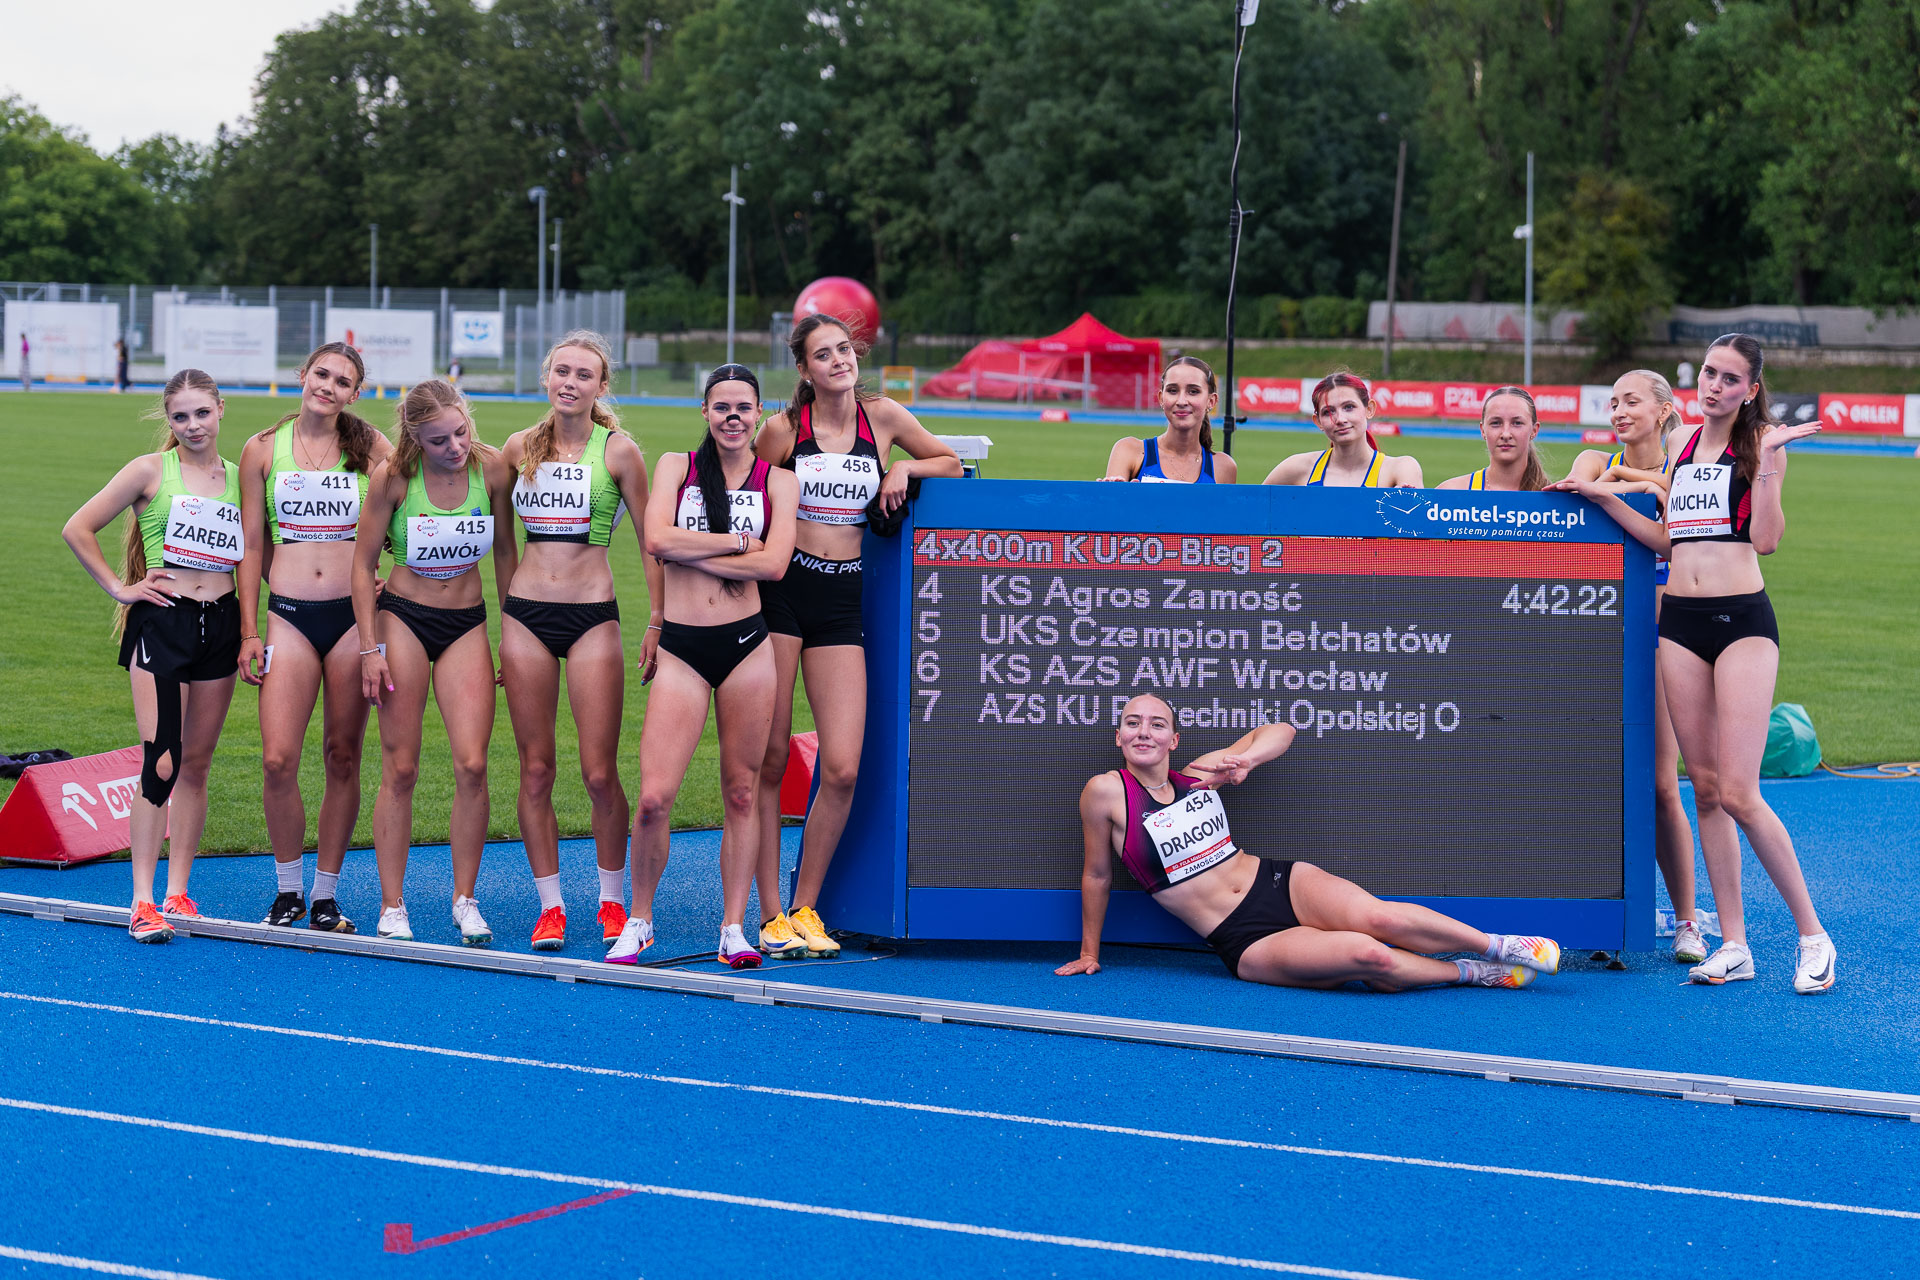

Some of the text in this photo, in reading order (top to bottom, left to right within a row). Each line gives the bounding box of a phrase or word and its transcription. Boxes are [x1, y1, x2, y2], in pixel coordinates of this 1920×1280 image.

[1849, 404, 1900, 424] ORLEN
[552, 466, 584, 481] 413
[842, 459, 871, 473] 458
[1693, 467, 1723, 482] 457
[321, 475, 351, 489] 411
[803, 481, 868, 500] MUCHA
[281, 500, 353, 517] CZARNY
[516, 491, 584, 508] MACHAJ
[1670, 493, 1720, 513] MUCHA
[216, 506, 240, 524] 414
[1427, 503, 1586, 530] domtel-sport.pl
[172, 522, 238, 551] ZARĘBA
[455, 520, 485, 534] 415
[1448, 526, 1489, 536] systemy
[1491, 527, 1534, 538] pomiaru
[416, 542, 481, 561] ZAWÓŁ
[916, 532, 1053, 562] 4x400m
[1260, 538, 1285, 568] 2
[793, 552, 838, 574] NIKE
[917, 571, 1618, 616] 4 KS Agros Zamość 4:42.22
[917, 610, 1451, 656] 5 UKS Czempion Bełchatów
[916, 650, 1389, 691] 6 KS AZS AWF Wrocław
[917, 689, 942, 722] 7
[978, 692, 1046, 724] AZS
[1056, 694, 1100, 725] KU
[1289, 699, 1427, 740] Opolskiej
[1434, 702, 1460, 732] O
[1186, 791, 1213, 813] 454
[1160, 813, 1224, 858] DRAGOW
